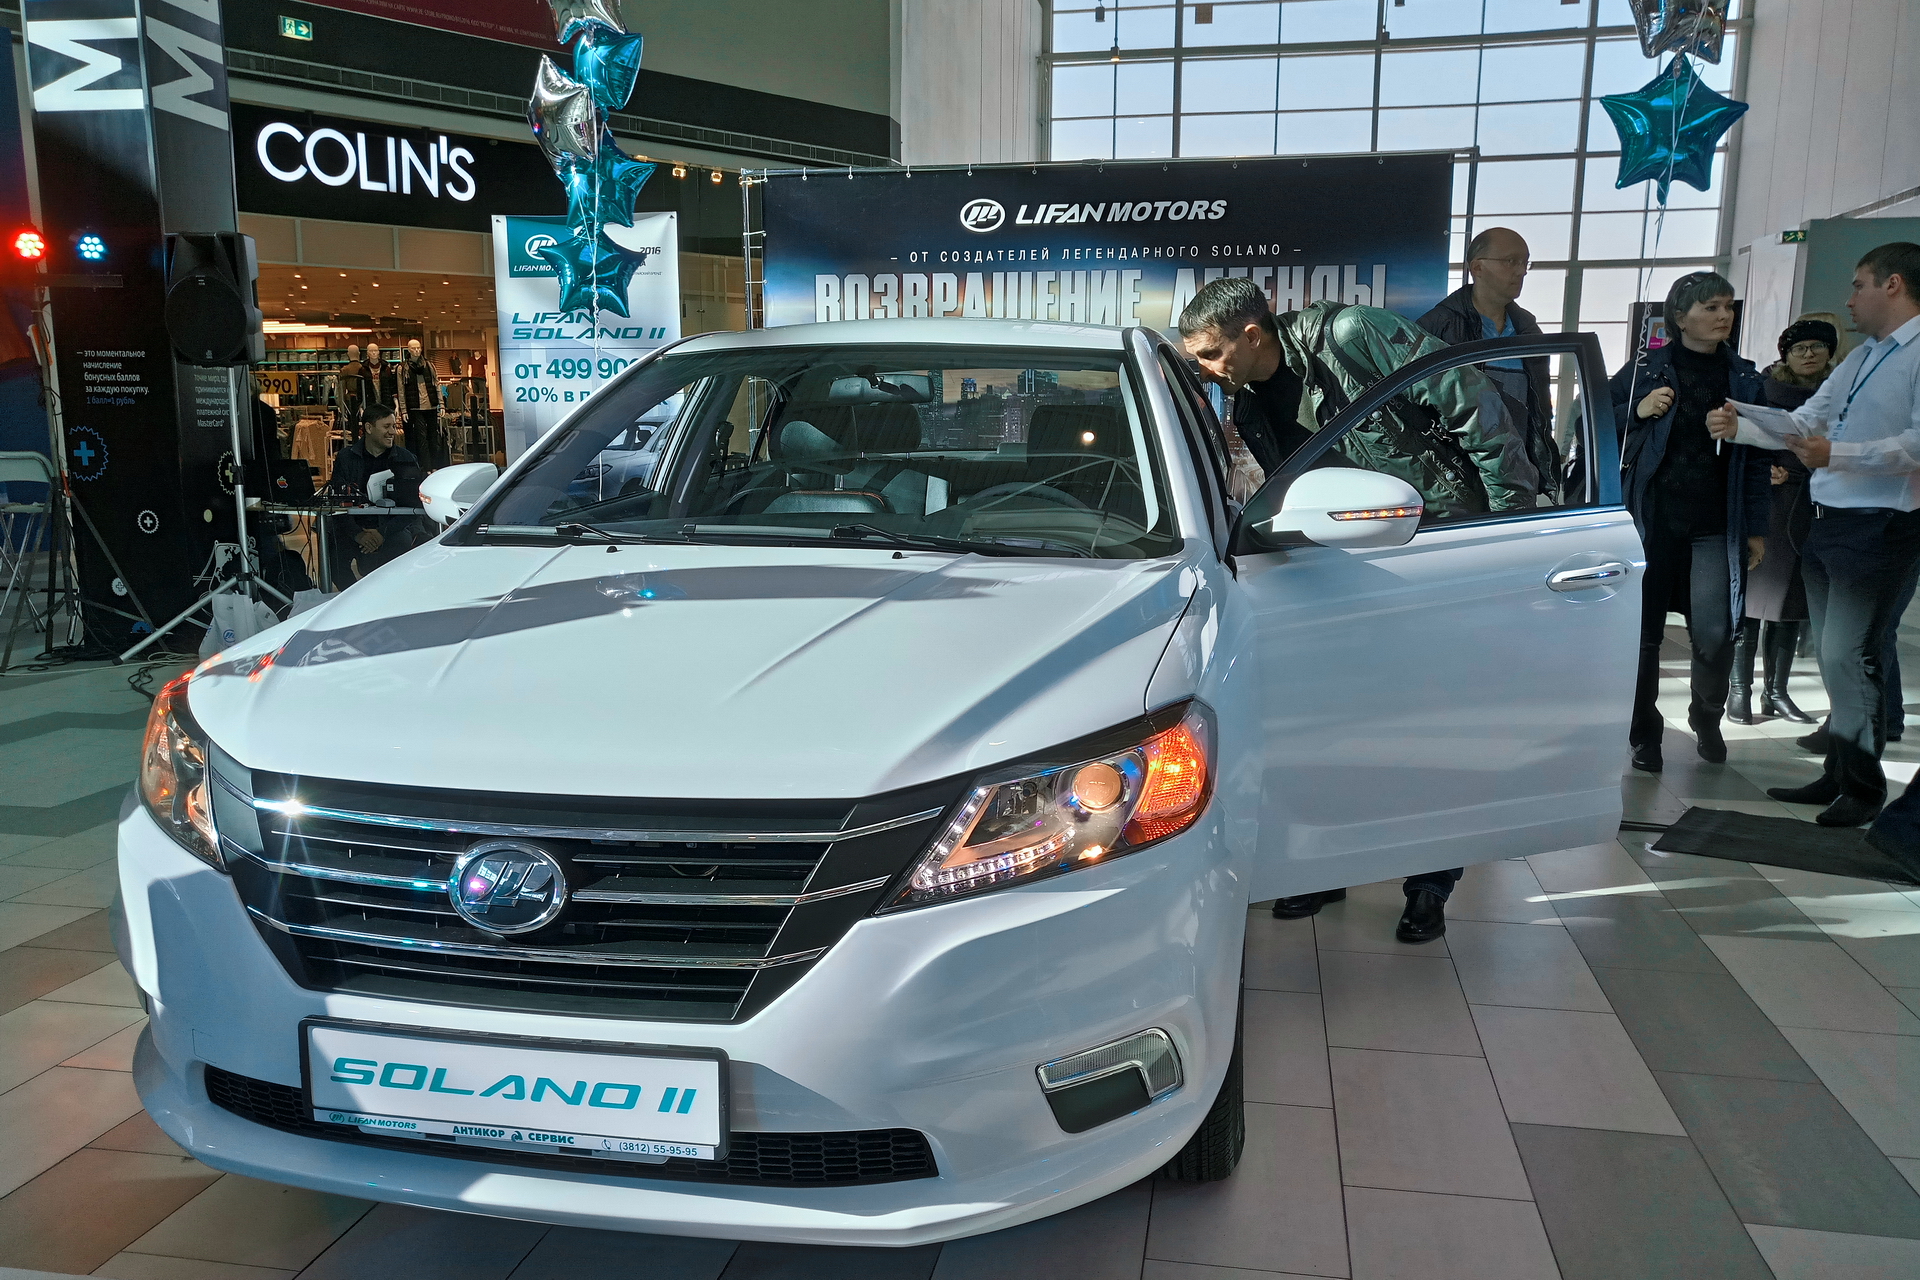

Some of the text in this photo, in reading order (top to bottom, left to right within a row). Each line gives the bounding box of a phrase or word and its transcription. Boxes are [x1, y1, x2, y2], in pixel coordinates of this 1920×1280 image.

[257, 122, 476, 202] COLIN'S
[1015, 200, 1228, 224] LIFAN MOTORS
[640, 246, 661, 255] 2016
[910, 251, 929, 263] ОТ
[940, 247, 1049, 264] СОЗДАТЕЛЕЙ
[1062, 245, 1199, 261] ЛЕГЕНДАРНОГО
[1211, 244, 1280, 257] SOLANO
[514, 264, 539, 272] LIFAN
[512, 312, 595, 324] LIFAN
[512, 327, 643, 340] SOLANO
[84, 350, 95, 358] это
[96, 350, 145, 358] моментальное
[83, 361, 122, 369] начисление
[514, 358, 639, 380] от 499 90
[84, 371, 141, 383] бонусных баллов
[85, 385, 149, 395] за каждую покупку.
[516, 386, 558, 402] 20%
[564, 391, 575, 402] в
[116, 396, 136, 406] рубль
[330, 1057, 697, 1114] SOLANO II
[347, 1116, 417, 1130] LIFAN MOTORS
[453, 1126, 575, 1145] АНТИКОР СЕРВИС
[619, 1142, 698, 1156] (3812) 55-95-95
